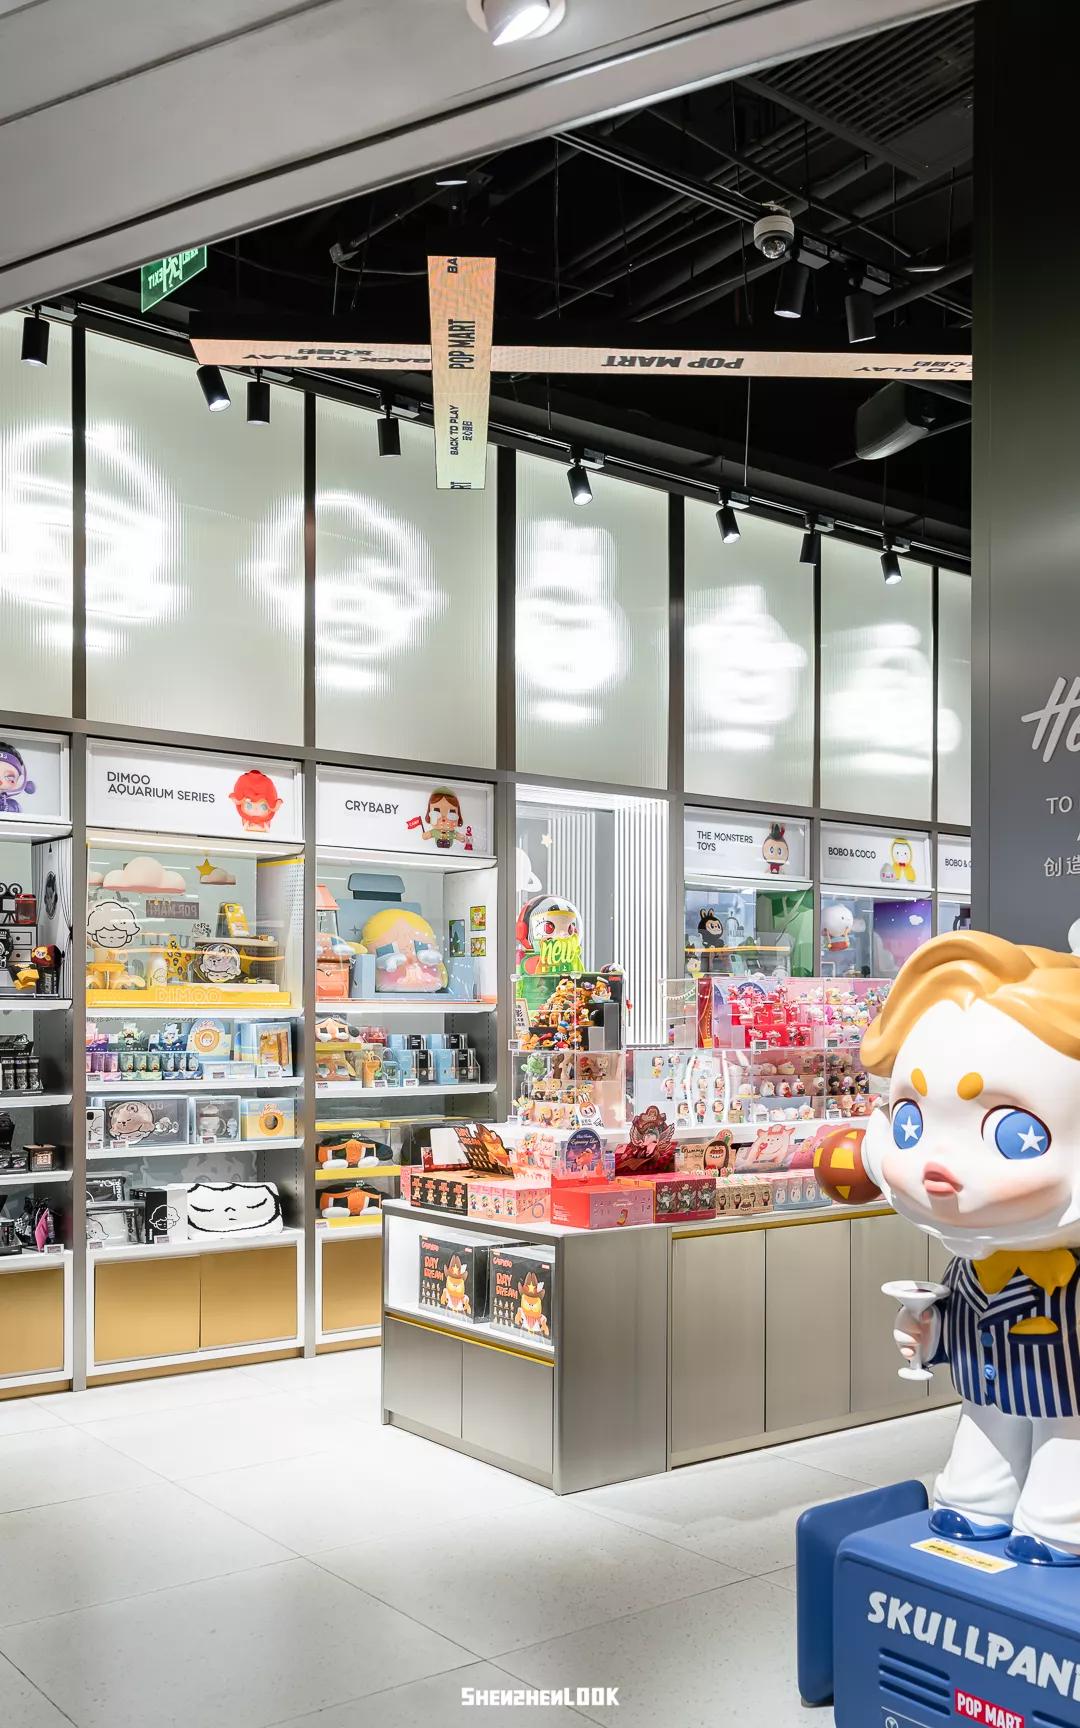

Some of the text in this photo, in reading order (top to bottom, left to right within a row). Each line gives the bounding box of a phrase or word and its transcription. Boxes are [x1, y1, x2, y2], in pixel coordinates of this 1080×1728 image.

[448, 319, 476, 370] POP MART
[601, 355, 745, 370] POP MART
[449, 404, 459, 456] BACK TO PLAY
[107, 771, 151, 785] DIMOO
[108, 783, 215, 803] AQUARIUM SERIES
[345, 799, 399, 815] CRYBABY
[1046, 796, 1073, 814] TO
[696, 830, 754, 844] THE MONSTERS
[696, 841, 717, 851] TOYS
[828, 847, 876, 859] BOBO & COCO
[945, 858, 962, 867] BOBO
[541, 936, 578, 965] new
[156, 987, 222, 1002] DIMOO
[957, 1692, 1023, 1728] POP MART
